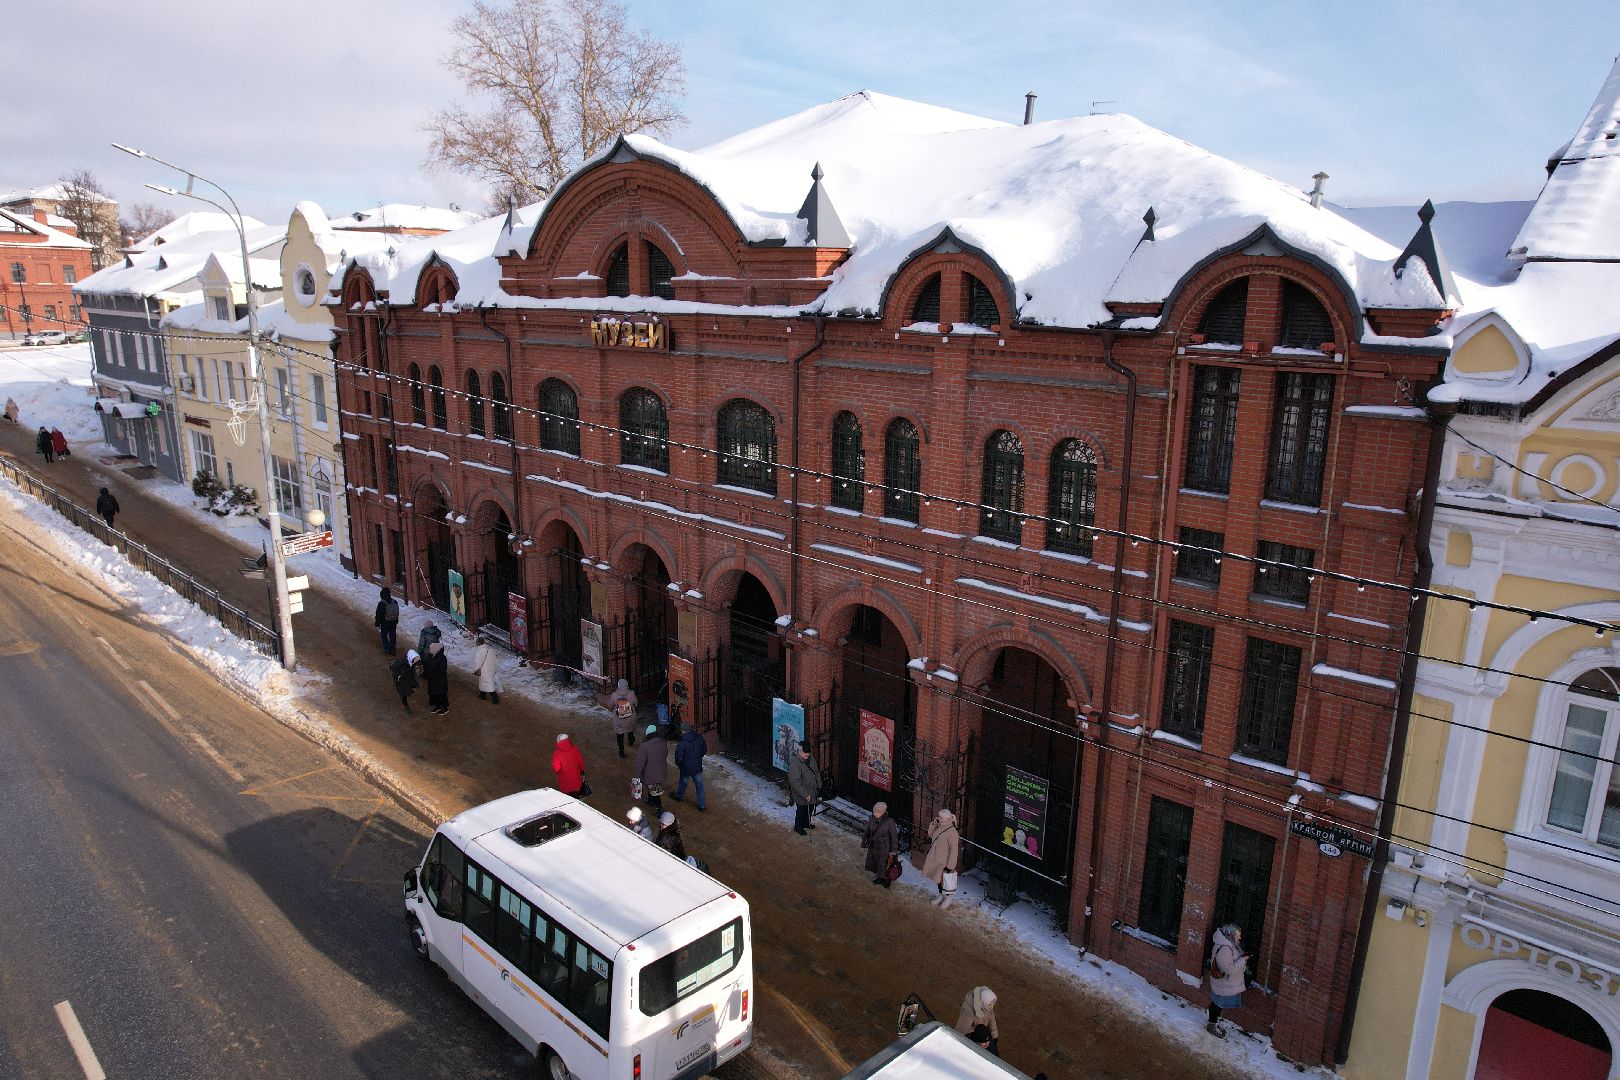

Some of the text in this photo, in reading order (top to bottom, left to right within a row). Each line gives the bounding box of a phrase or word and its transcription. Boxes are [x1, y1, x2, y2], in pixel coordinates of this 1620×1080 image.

[591, 317, 664, 348] МУЗЕЙ
[1294, 822, 1335, 841] КРАСНОЙ
[1340, 838, 1372, 854] АРМИИ
